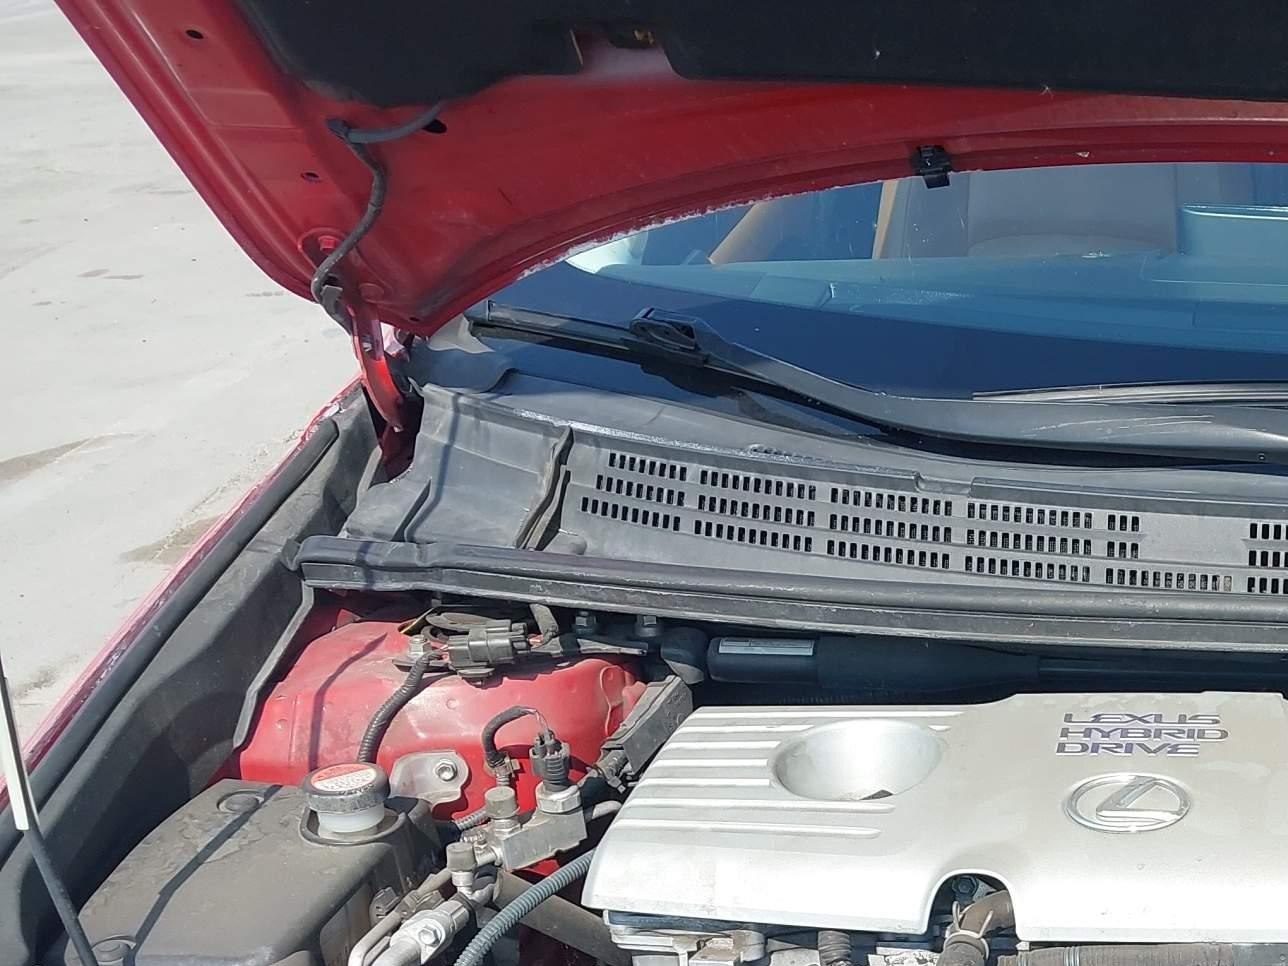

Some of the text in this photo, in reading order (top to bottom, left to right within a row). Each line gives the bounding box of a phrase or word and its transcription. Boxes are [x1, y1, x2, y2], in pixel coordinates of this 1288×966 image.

[1063, 713, 1221, 725] LEXUS
[1060, 727, 1229, 740] HYBRID
[1056, 742, 1200, 755] DRIVE
